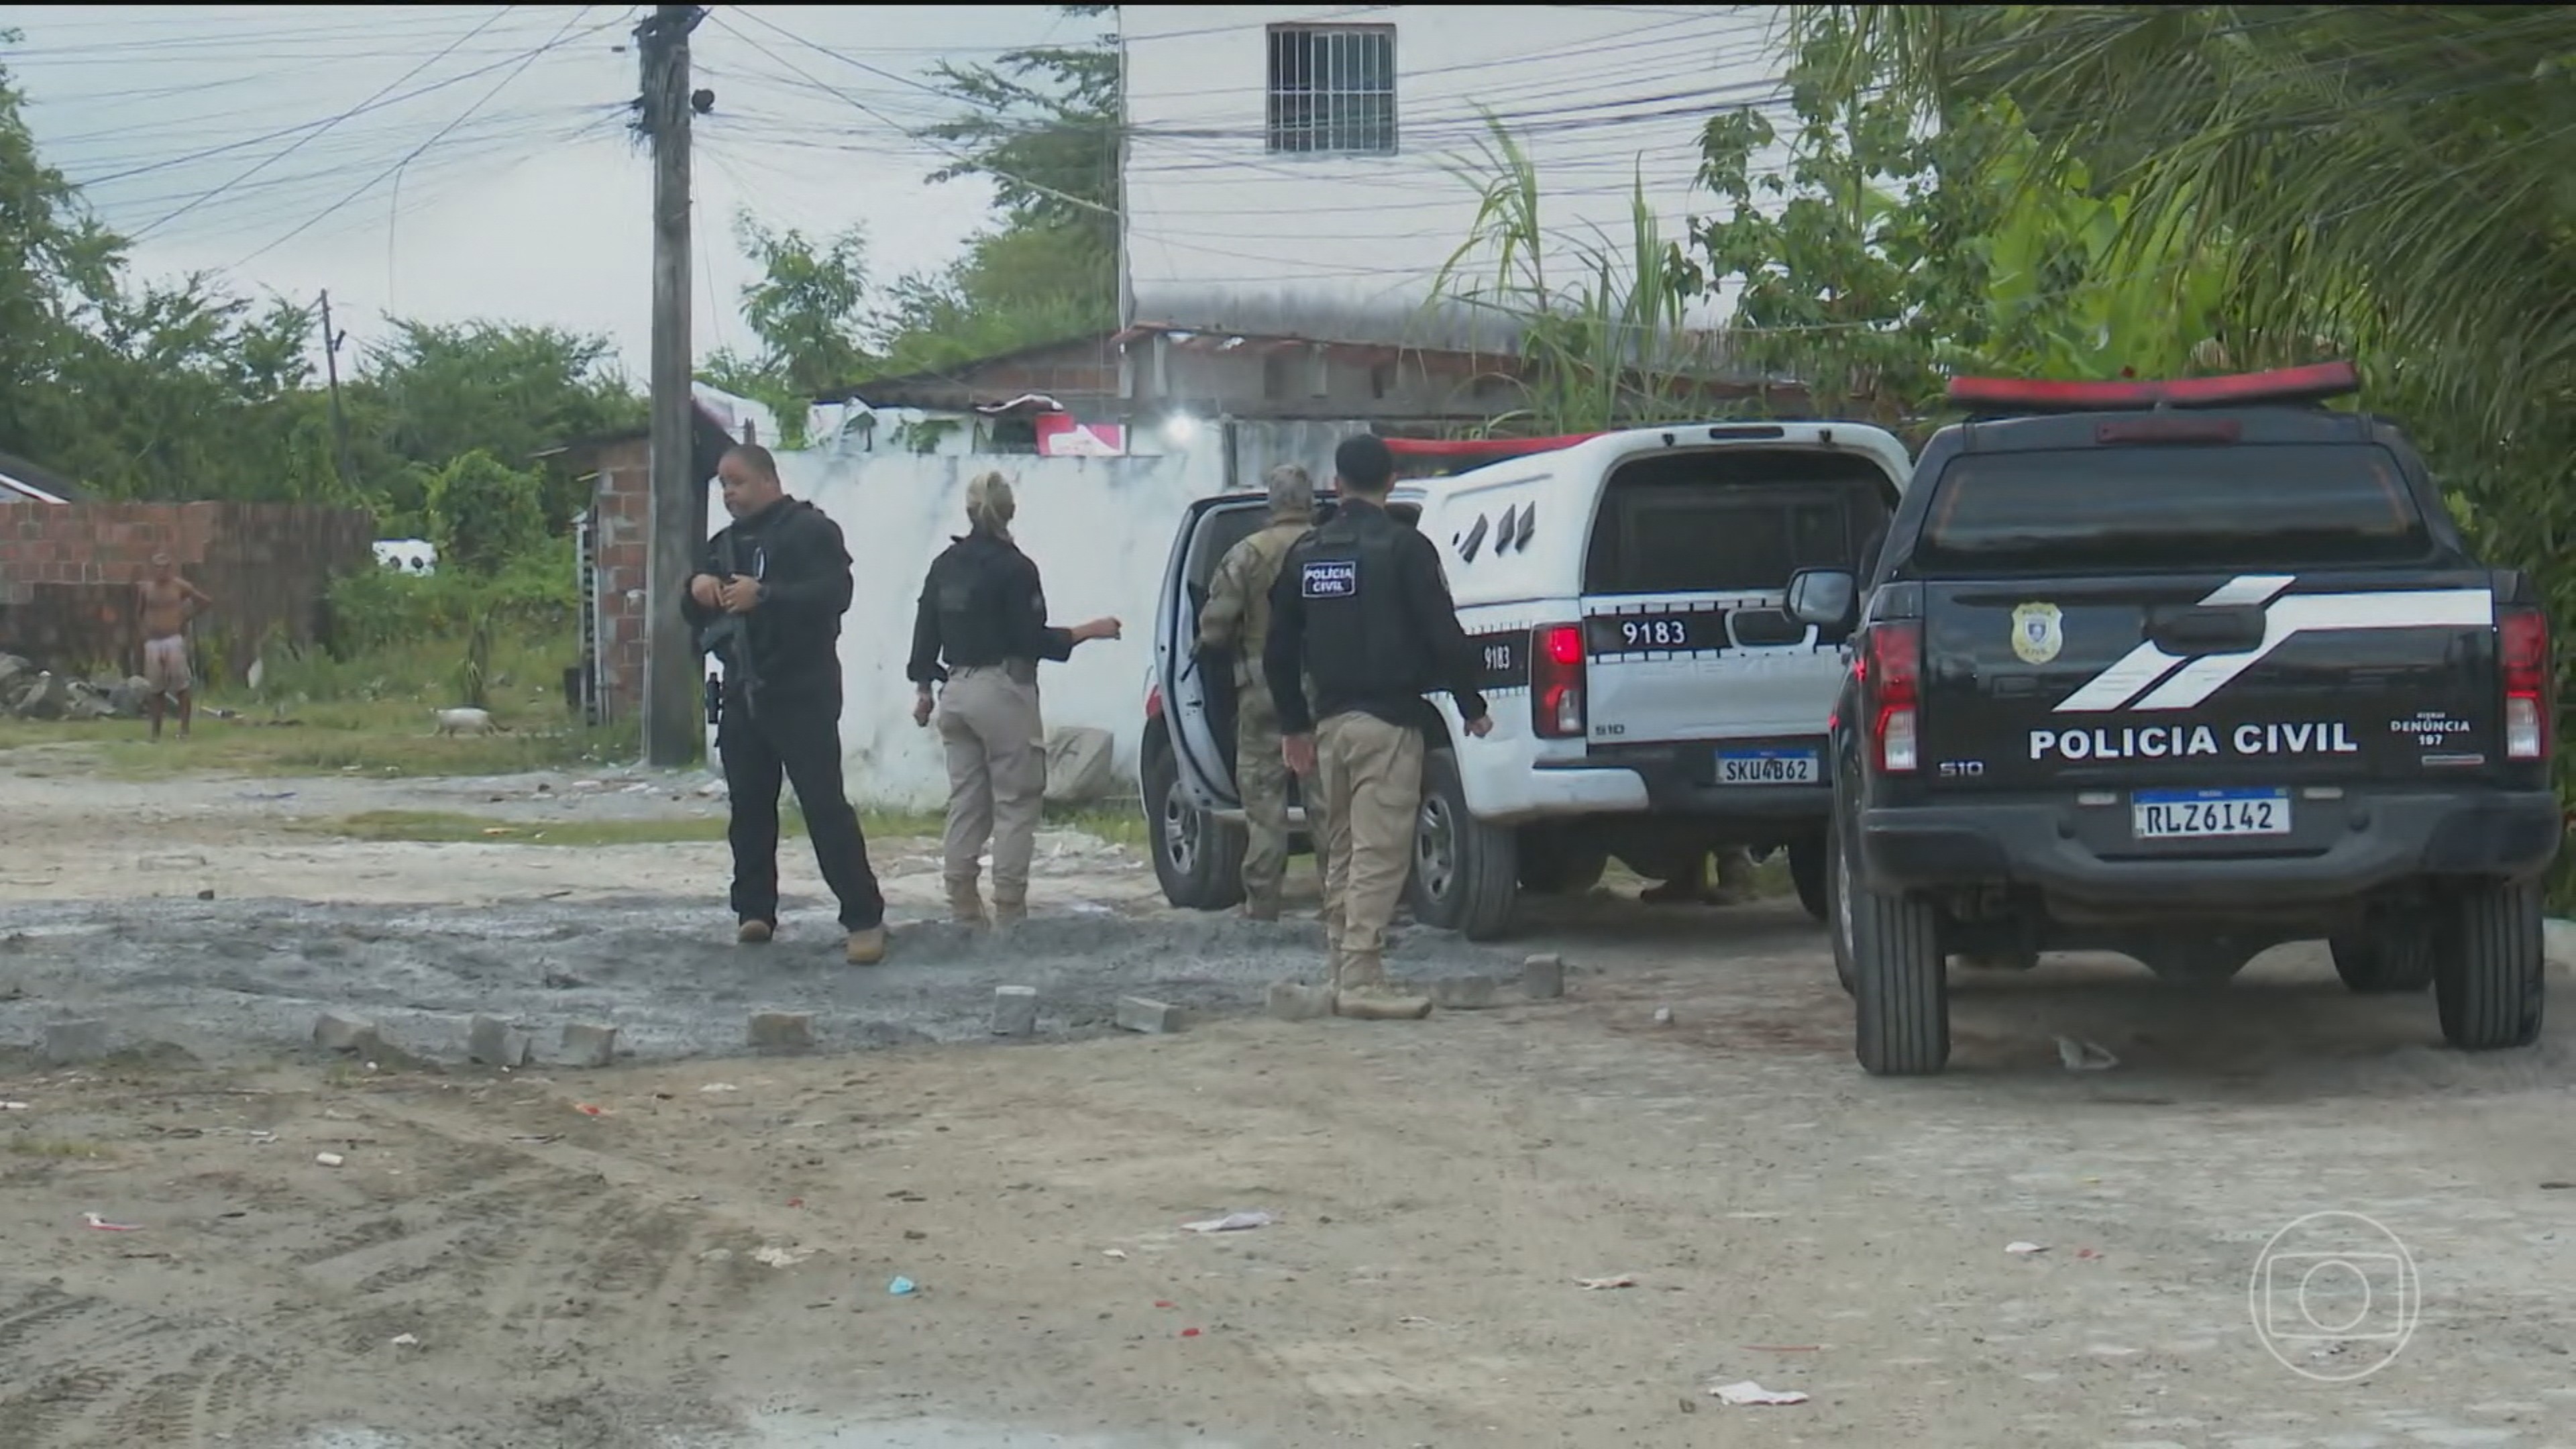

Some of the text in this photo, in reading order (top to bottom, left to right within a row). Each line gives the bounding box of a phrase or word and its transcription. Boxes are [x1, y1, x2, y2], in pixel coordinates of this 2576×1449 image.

[1313, 581, 1344, 592] CIVIL
[1621, 622, 1685, 644] 9183
[1484, 646, 1510, 669] 9183
[2390, 719, 2470, 732] DENÚNCIA
[2029, 722, 2357, 759] POLICIA CIVIL
[1726, 761, 1807, 780] SKU4B62
[1940, 761, 1984, 776] S10
[2147, 803, 2273, 833] RLZ6I42
